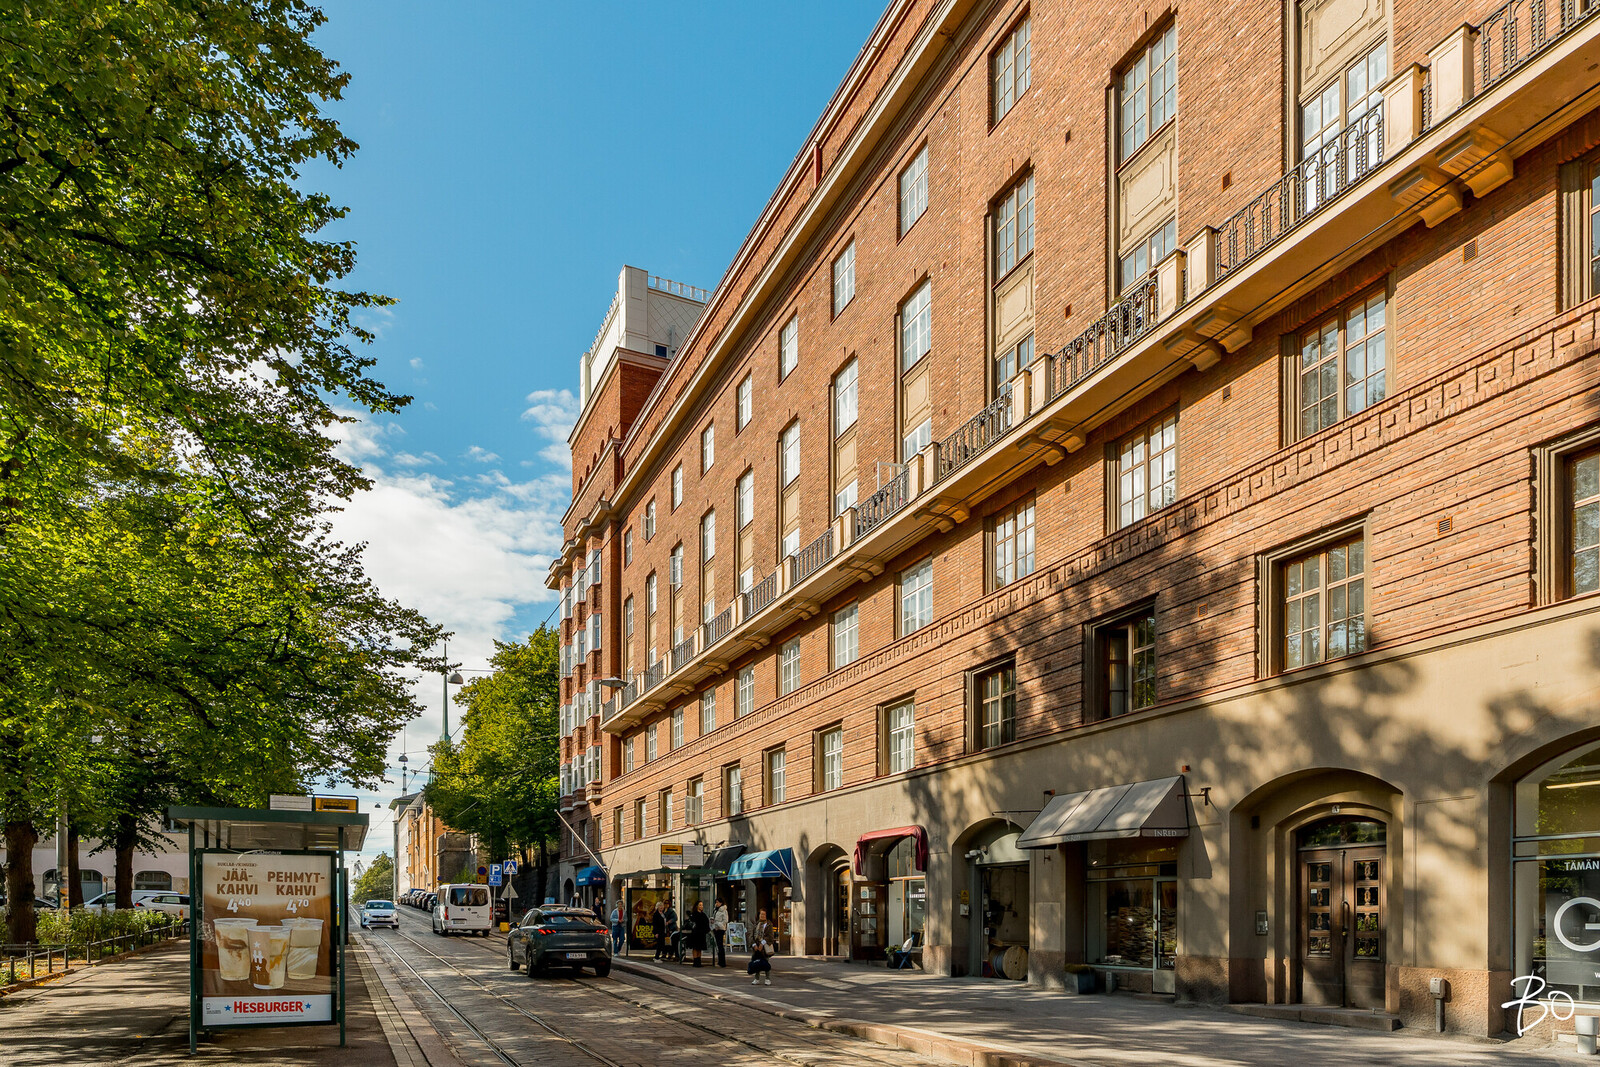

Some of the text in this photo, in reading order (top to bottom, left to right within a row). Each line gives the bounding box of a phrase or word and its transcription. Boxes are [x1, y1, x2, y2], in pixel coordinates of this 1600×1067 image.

[492, 865, 500, 875] P
[1564, 859, 1600, 871] TÄMÄN
[222, 868, 254, 882] JÄÄ-
[267, 871, 326, 883] PEHMYT-
[216, 883, 259, 895] KAHVI
[276, 884, 316, 896] KAHVI
[233, 1000, 304, 1014] HESBURGER
